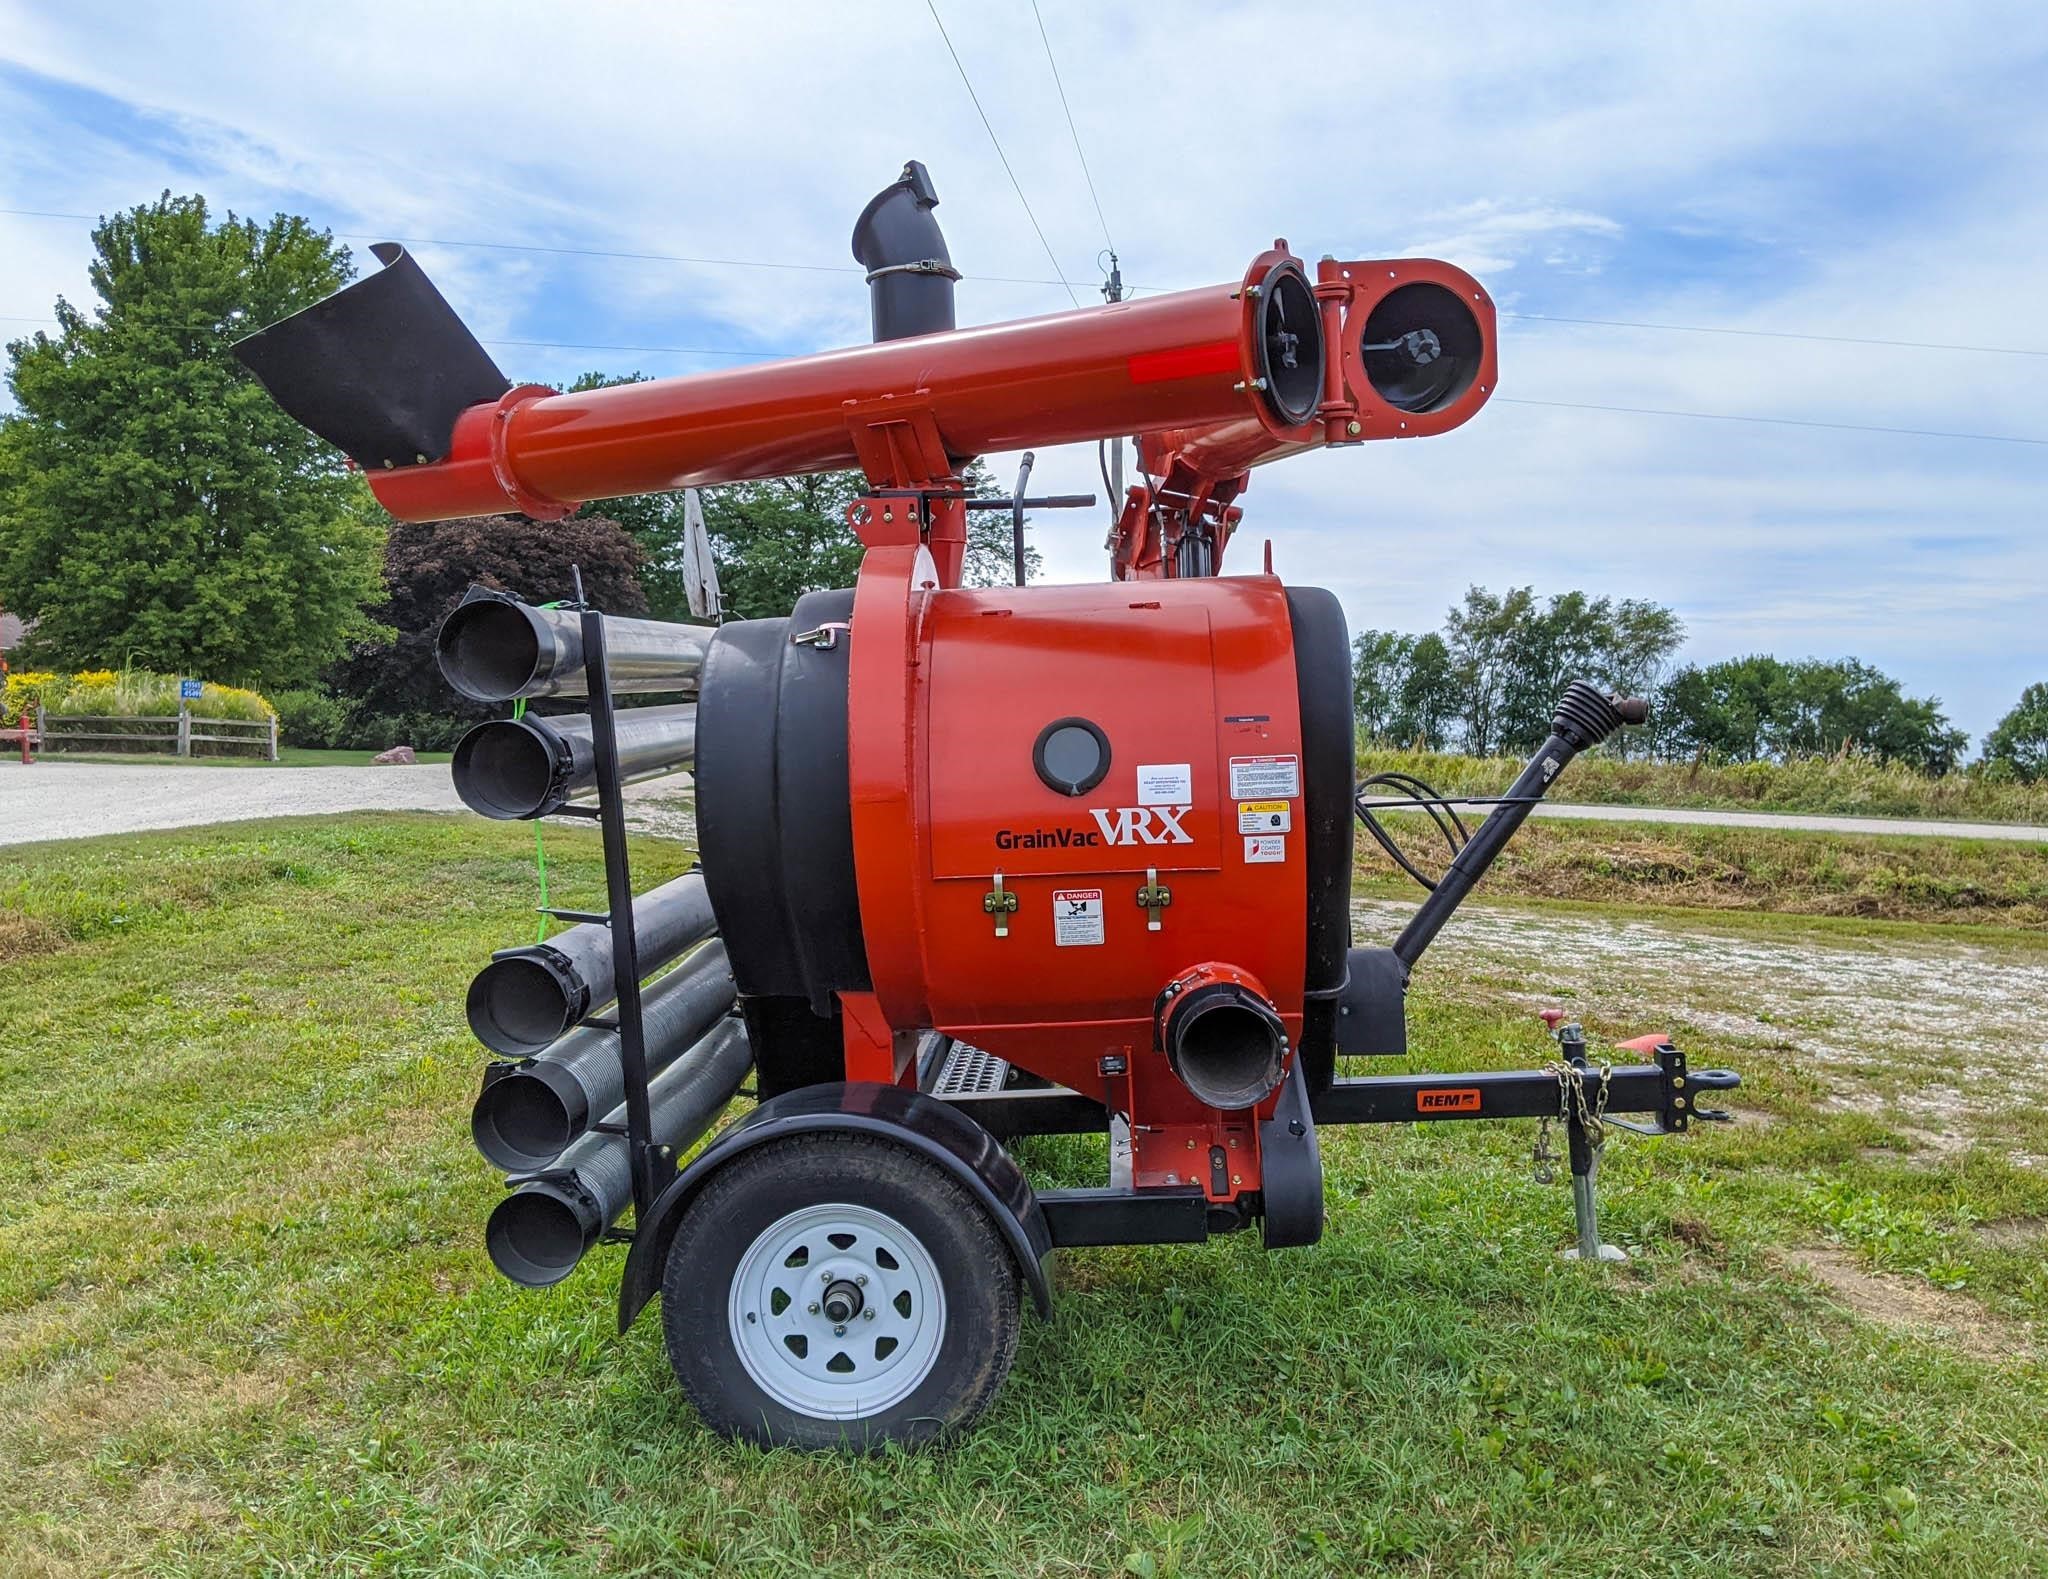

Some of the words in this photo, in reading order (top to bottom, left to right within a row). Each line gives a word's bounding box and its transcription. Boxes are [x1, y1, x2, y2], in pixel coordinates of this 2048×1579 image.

[995, 828, 1099, 850] GrainVac
[1089, 806, 1194, 845] VRX
[1066, 892, 1099, 900] DANGER
[1422, 1094, 1461, 1107] REM
